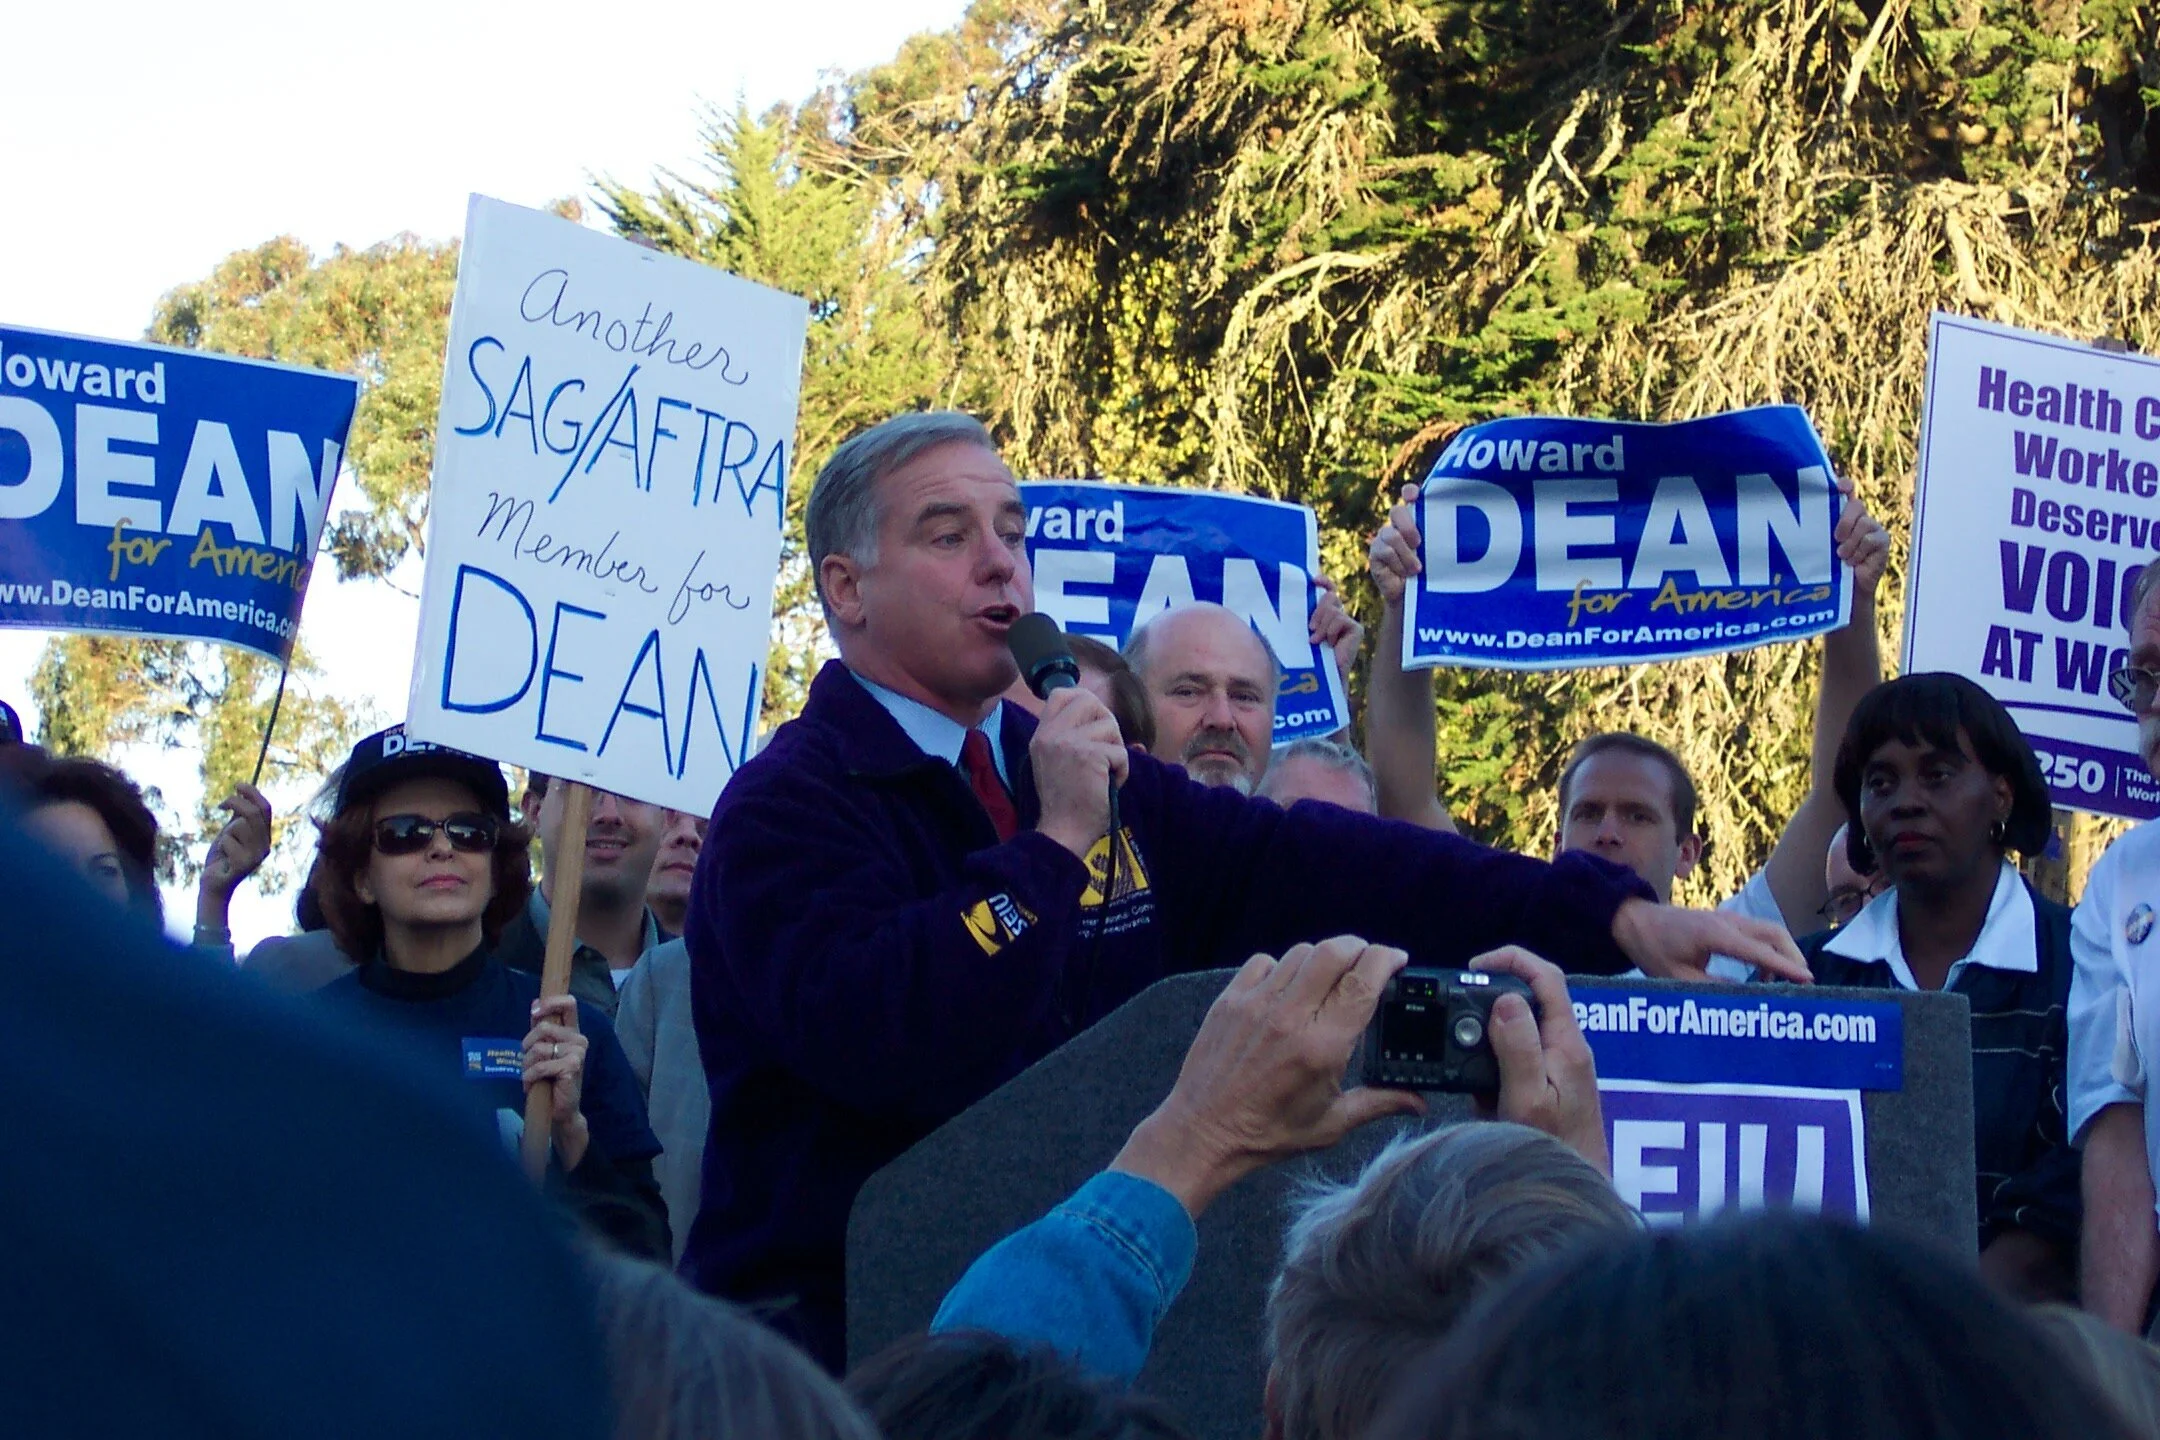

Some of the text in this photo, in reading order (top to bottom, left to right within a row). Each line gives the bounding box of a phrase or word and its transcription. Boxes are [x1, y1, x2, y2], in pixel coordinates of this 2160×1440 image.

[521, 269, 749, 385] Another
[0, 341, 166, 405] oward
[1978, 365, 2123, 435] Health
[454, 336, 785, 531] SAG/AFTRA
[1437, 434, 1626, 473] Howard
[107, 517, 172, 581] for
[477, 491, 750, 625] Member for
[1424, 465, 1833, 593] DEAN
[1418, 608, 1835, 649] www.DeanForAmerica.com
[1567, 573, 1832, 628] for America
[441, 562, 759, 780] DEAN
[1980, 623, 2043, 683] AT
[2124, 767, 2152, 785] The
